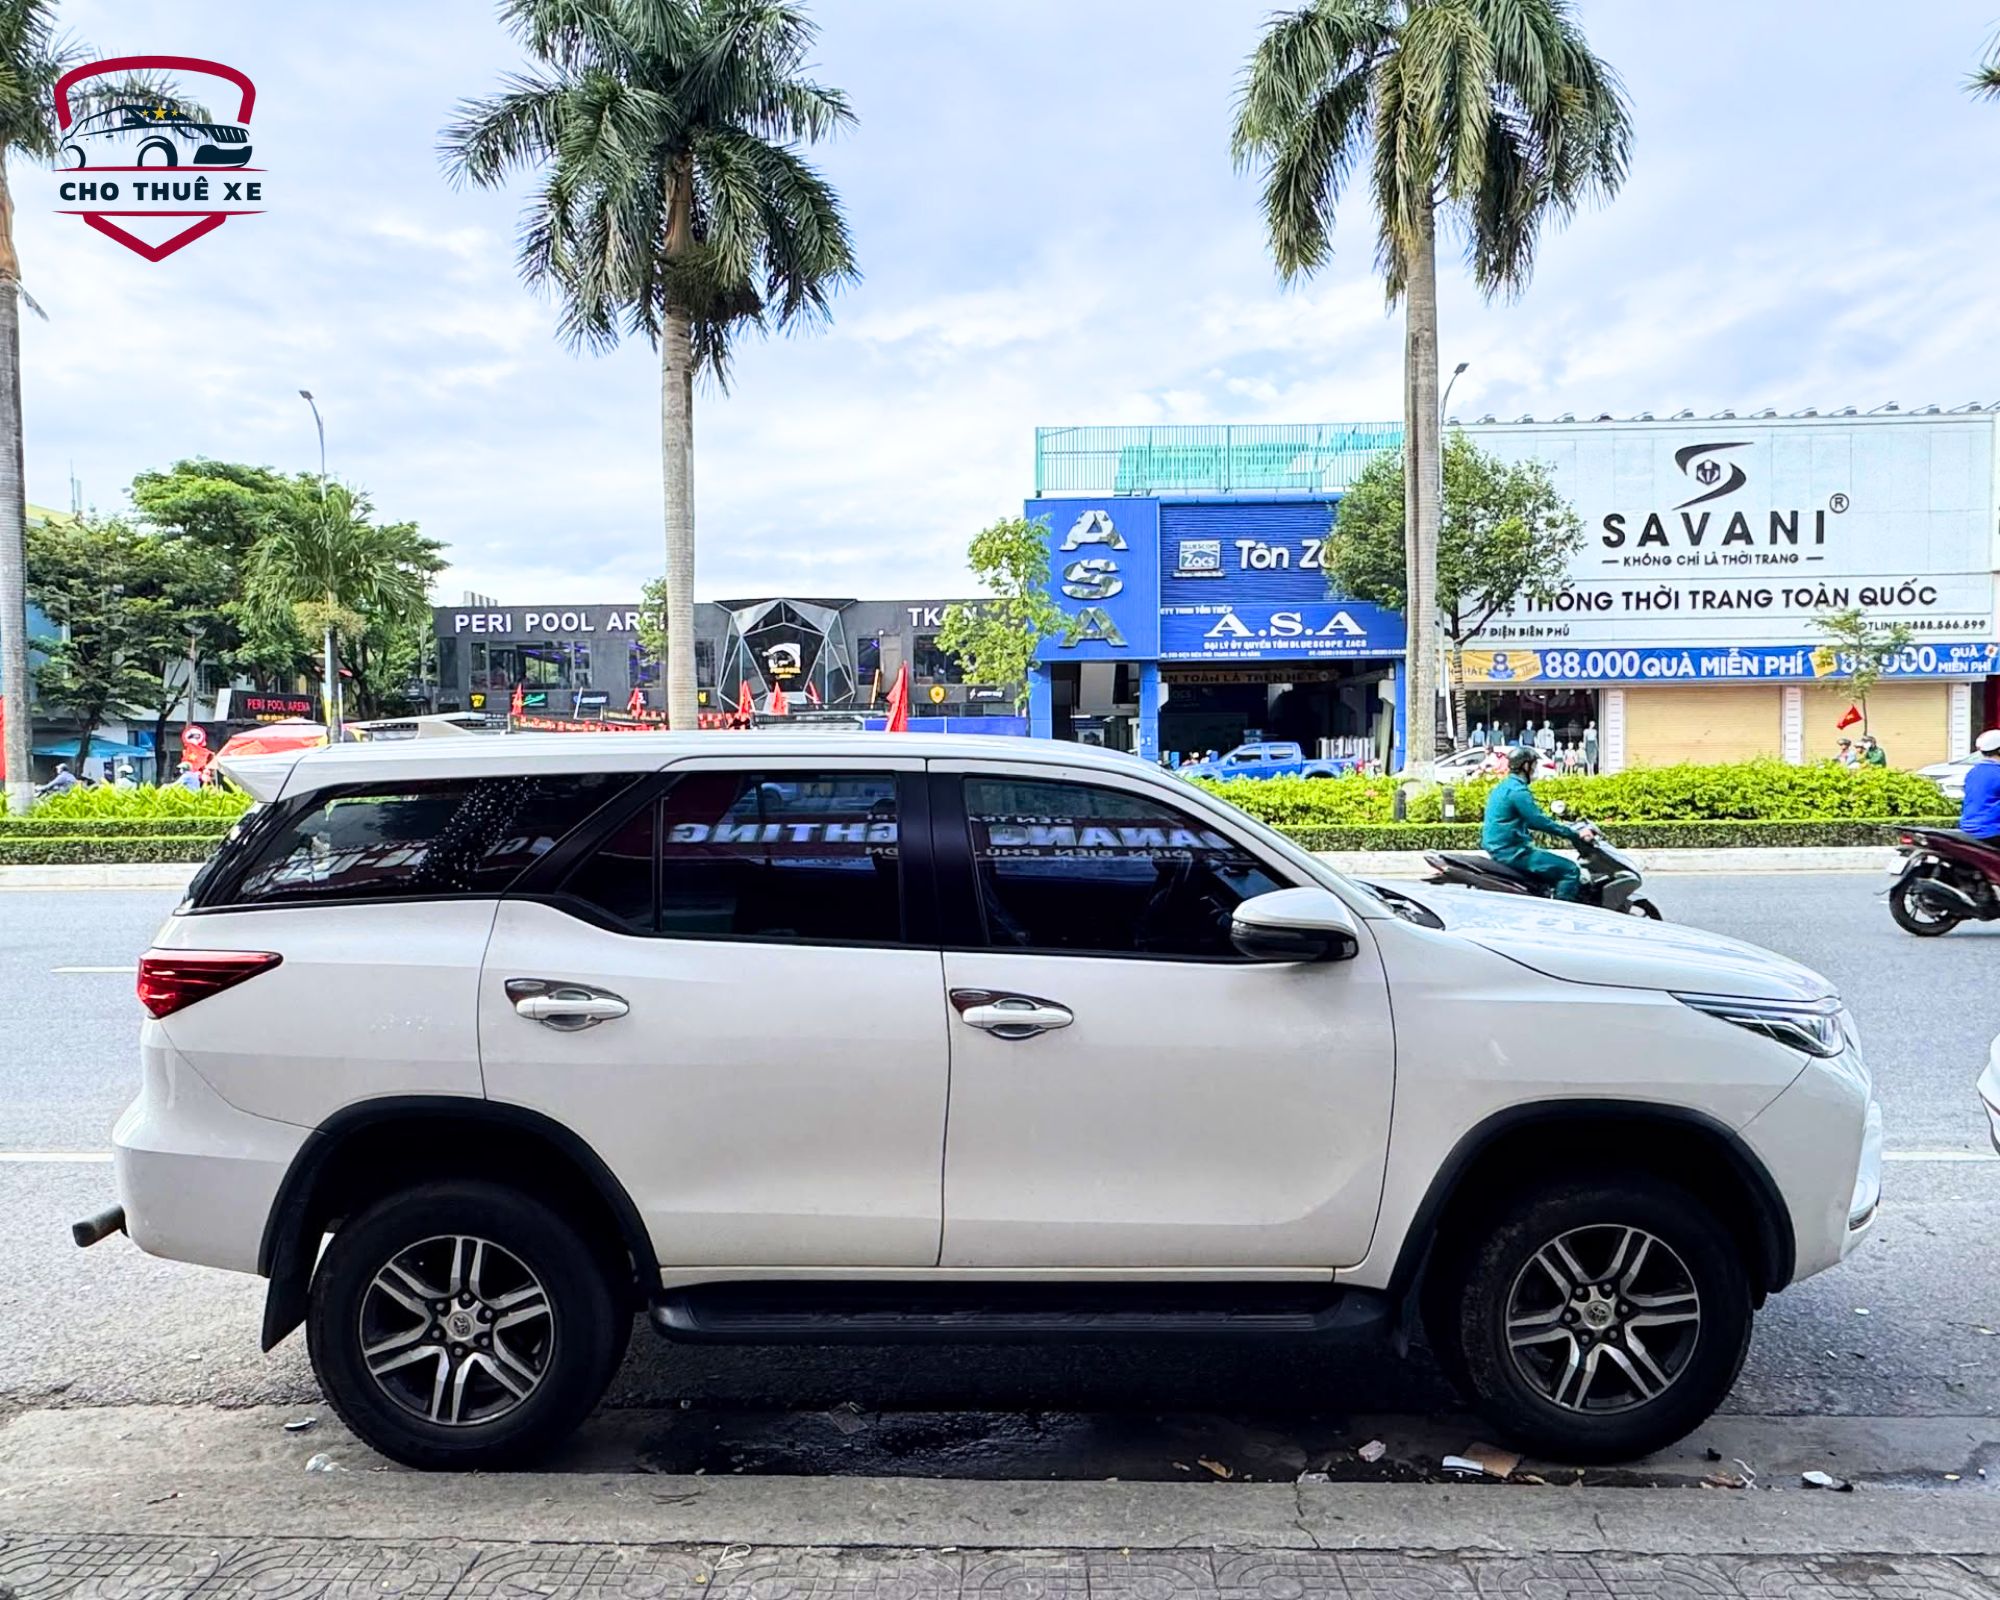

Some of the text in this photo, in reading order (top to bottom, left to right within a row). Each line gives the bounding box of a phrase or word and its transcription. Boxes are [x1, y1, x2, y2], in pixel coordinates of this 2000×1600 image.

[1602, 510, 1825, 548] SAVANI
[1184, 553, 1215, 568] Zacs
[1235, 540, 1290, 570] Tôn
[1755, 553, 1799, 565] TRANG
[1622, 585, 1679, 611] THỜI
[1689, 588, 1773, 610] TRANG
[1782, 583, 1848, 608] TOÀN
[1859, 578, 1937, 606] QUỐC
[455, 613, 512, 633] PERI
[526, 612, 595, 632] POOL
[1203, 611, 1367, 638] A.S.A
[1545, 651, 1640, 679] 88.000
[1642, 651, 1695, 677] QUÀ
[1765, 650, 1804, 676] PHÍ
